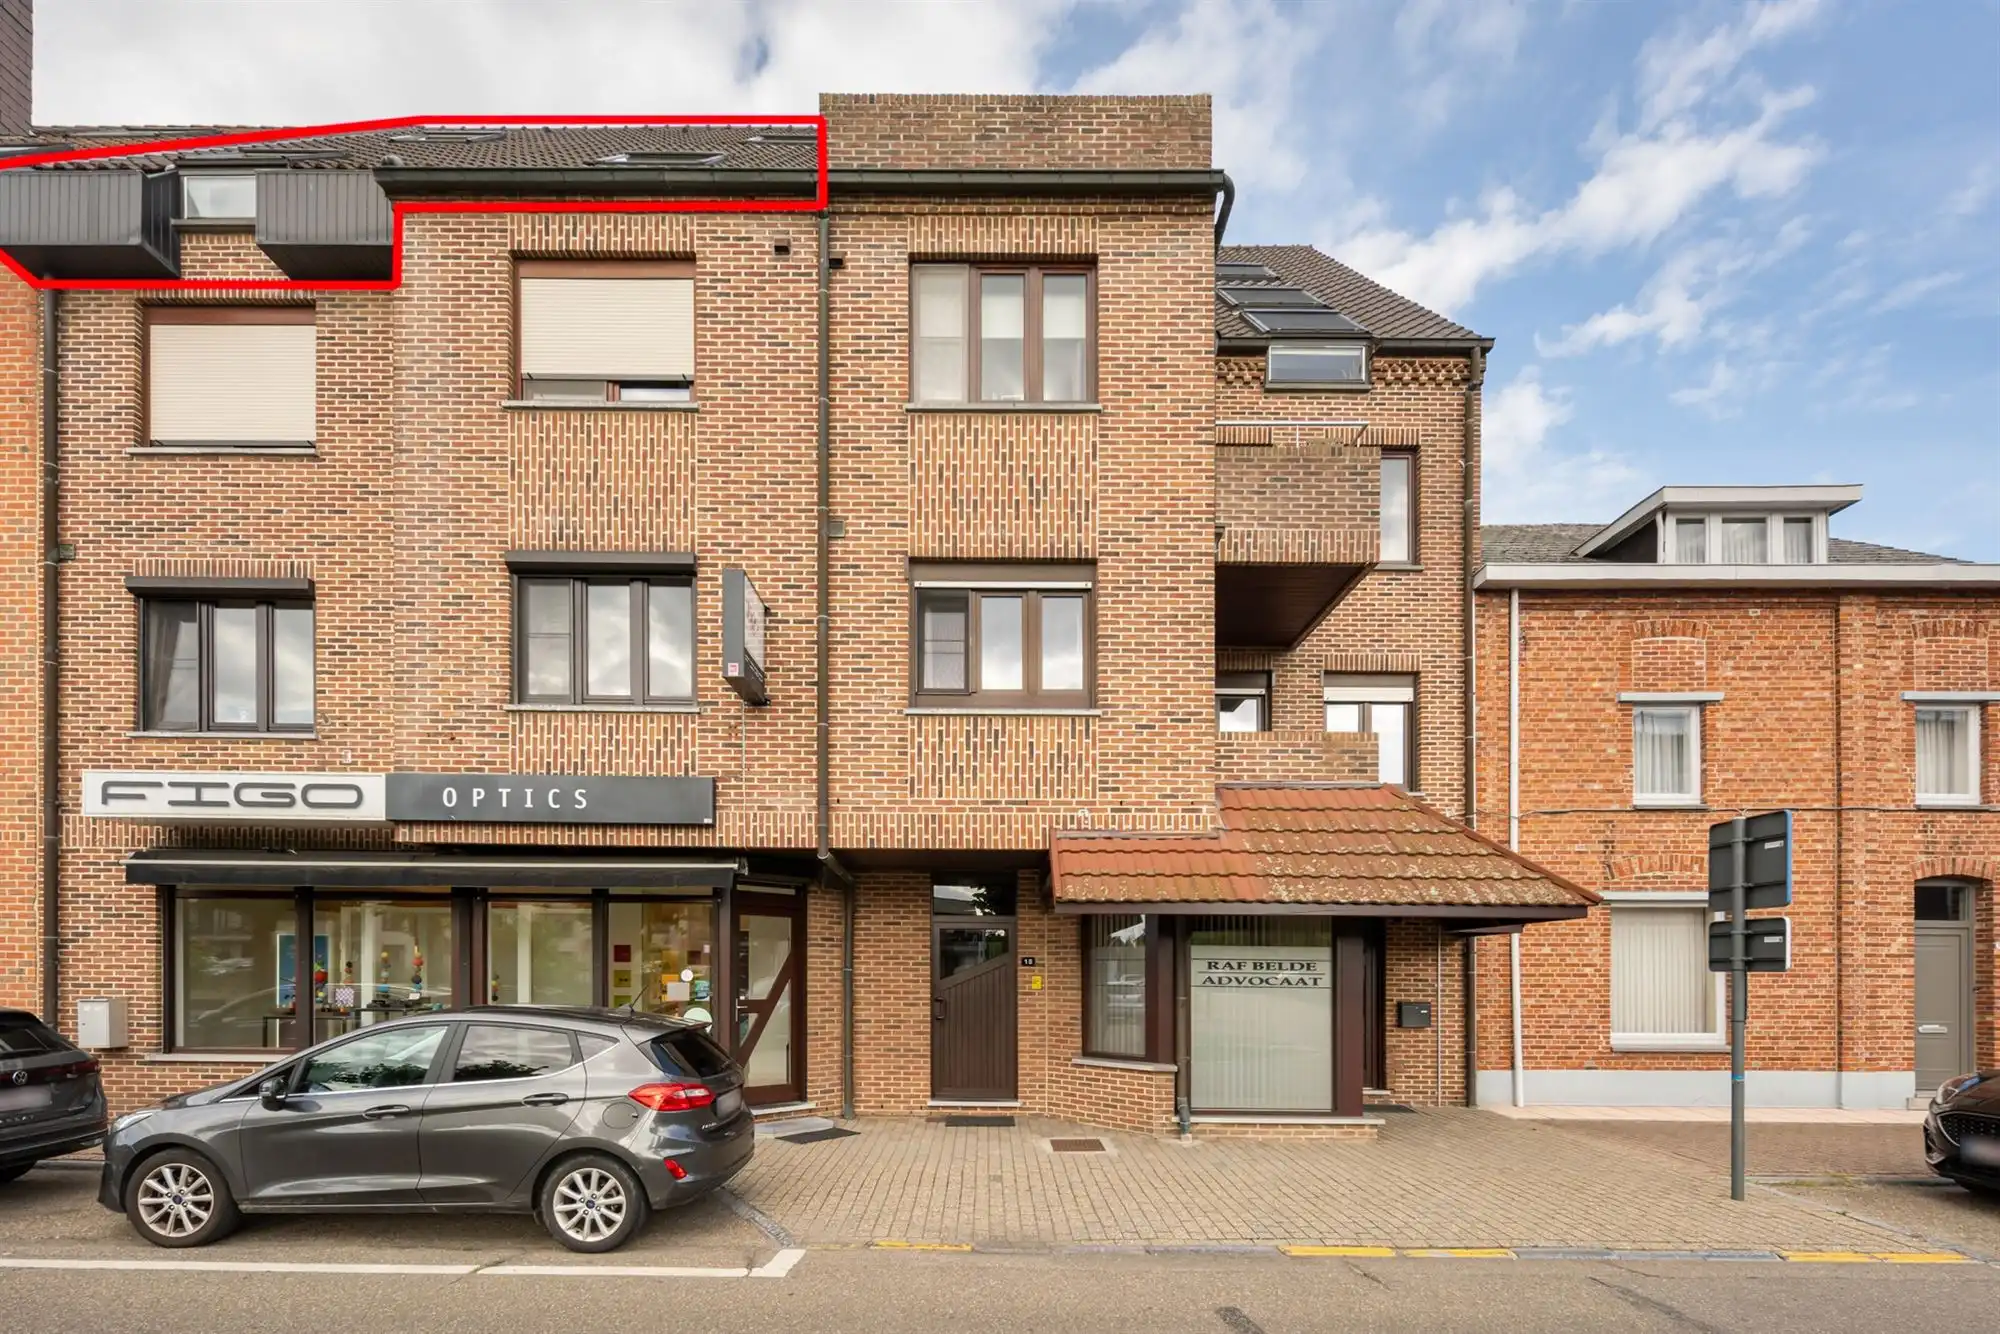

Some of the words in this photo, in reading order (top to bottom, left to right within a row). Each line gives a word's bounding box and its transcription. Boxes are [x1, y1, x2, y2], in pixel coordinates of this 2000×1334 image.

[101, 781, 364, 809] FIGO
[442, 787, 588, 809] OPTICS
[1207, 961, 1247, 970] RAF
[1252, 961, 1318, 971] BELDE
[1202, 975, 1323, 986] ADVOCAAT
